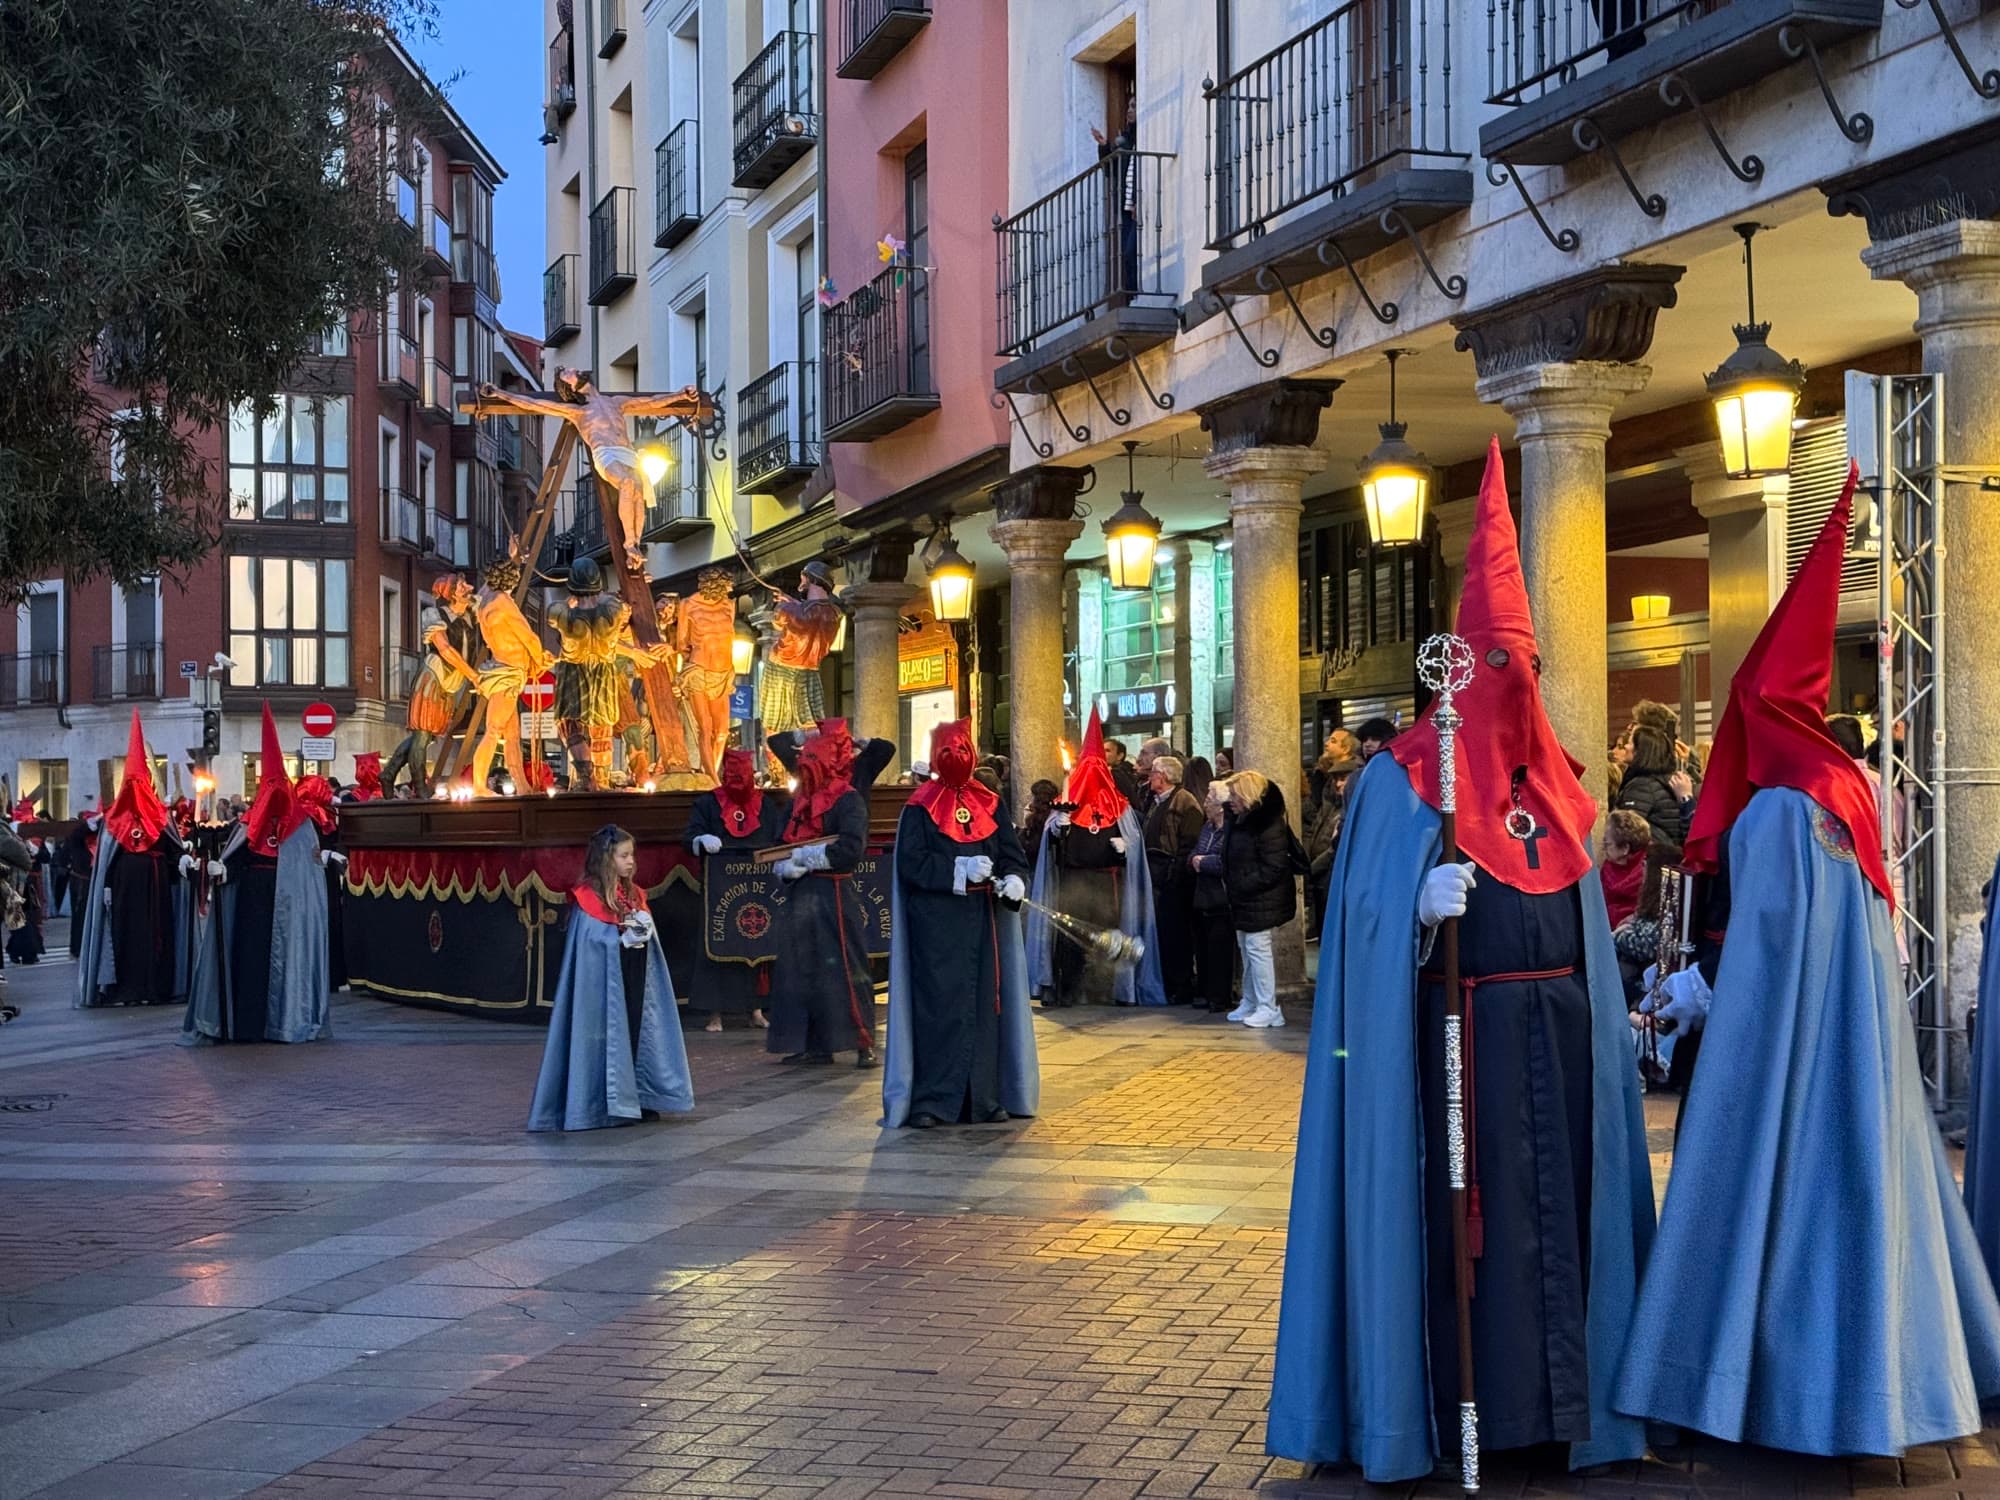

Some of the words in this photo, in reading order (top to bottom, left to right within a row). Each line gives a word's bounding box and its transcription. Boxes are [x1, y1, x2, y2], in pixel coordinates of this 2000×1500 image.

[712, 882, 749, 942] EXALTACION
[752, 881, 767, 894] DE
[770, 888, 787, 906] LA
[868, 887, 884, 905] LA
